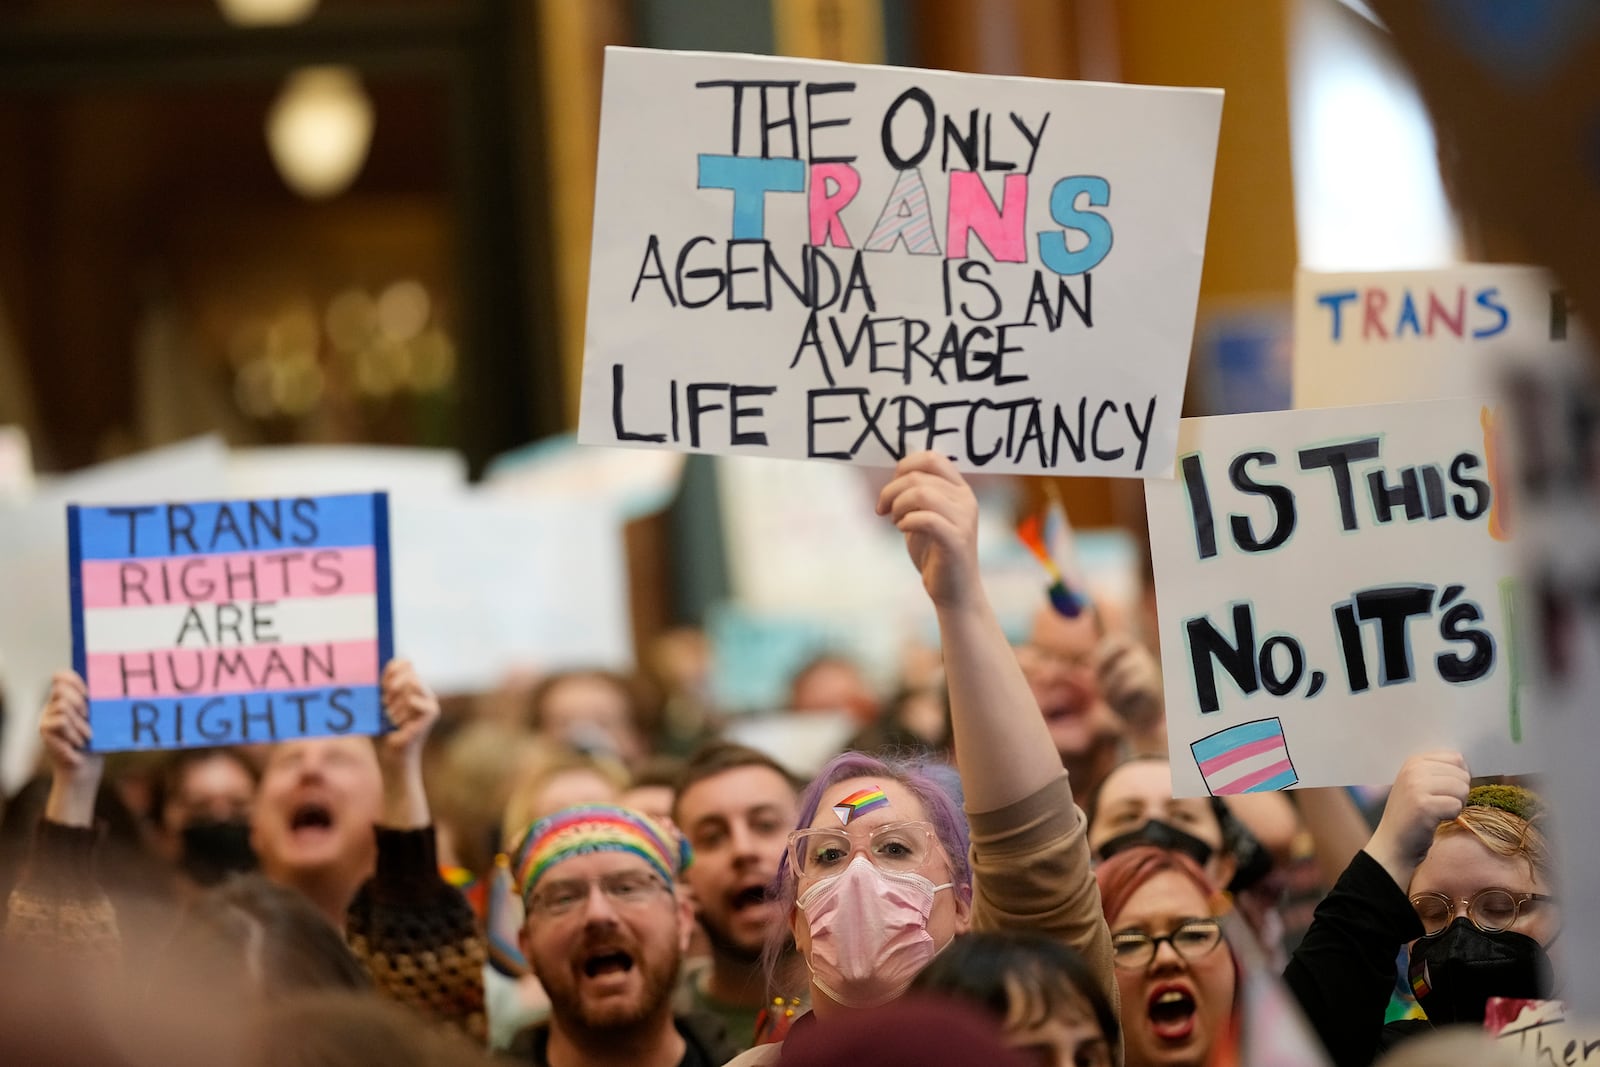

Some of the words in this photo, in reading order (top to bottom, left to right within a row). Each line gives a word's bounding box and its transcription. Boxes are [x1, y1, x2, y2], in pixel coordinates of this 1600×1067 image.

[696, 81, 856, 163] THE
[881, 86, 1050, 175] ONLY
[697, 153, 1114, 276] TRANS
[631, 235, 877, 313] AGENDA
[942, 258, 1002, 321] IS
[1024, 271, 1093, 332] AN
[1314, 287, 1511, 344] TRANS
[789, 308, 1038, 386] AVERAGE
[611, 364, 777, 448] LIFE
[807, 387, 1157, 471] EXPECTANCY
[107, 496, 320, 555] TRANS
[1180, 451, 1297, 560] IS
[1298, 437, 1492, 532] THIS
[119, 550, 345, 605] RIGHTS
[176, 602, 281, 647] ARE
[1186, 603, 1326, 714] NO,
[1333, 583, 1496, 693] IT'S
[119, 644, 336, 696] HUMAN
[131, 688, 355, 744] RIGHTS
